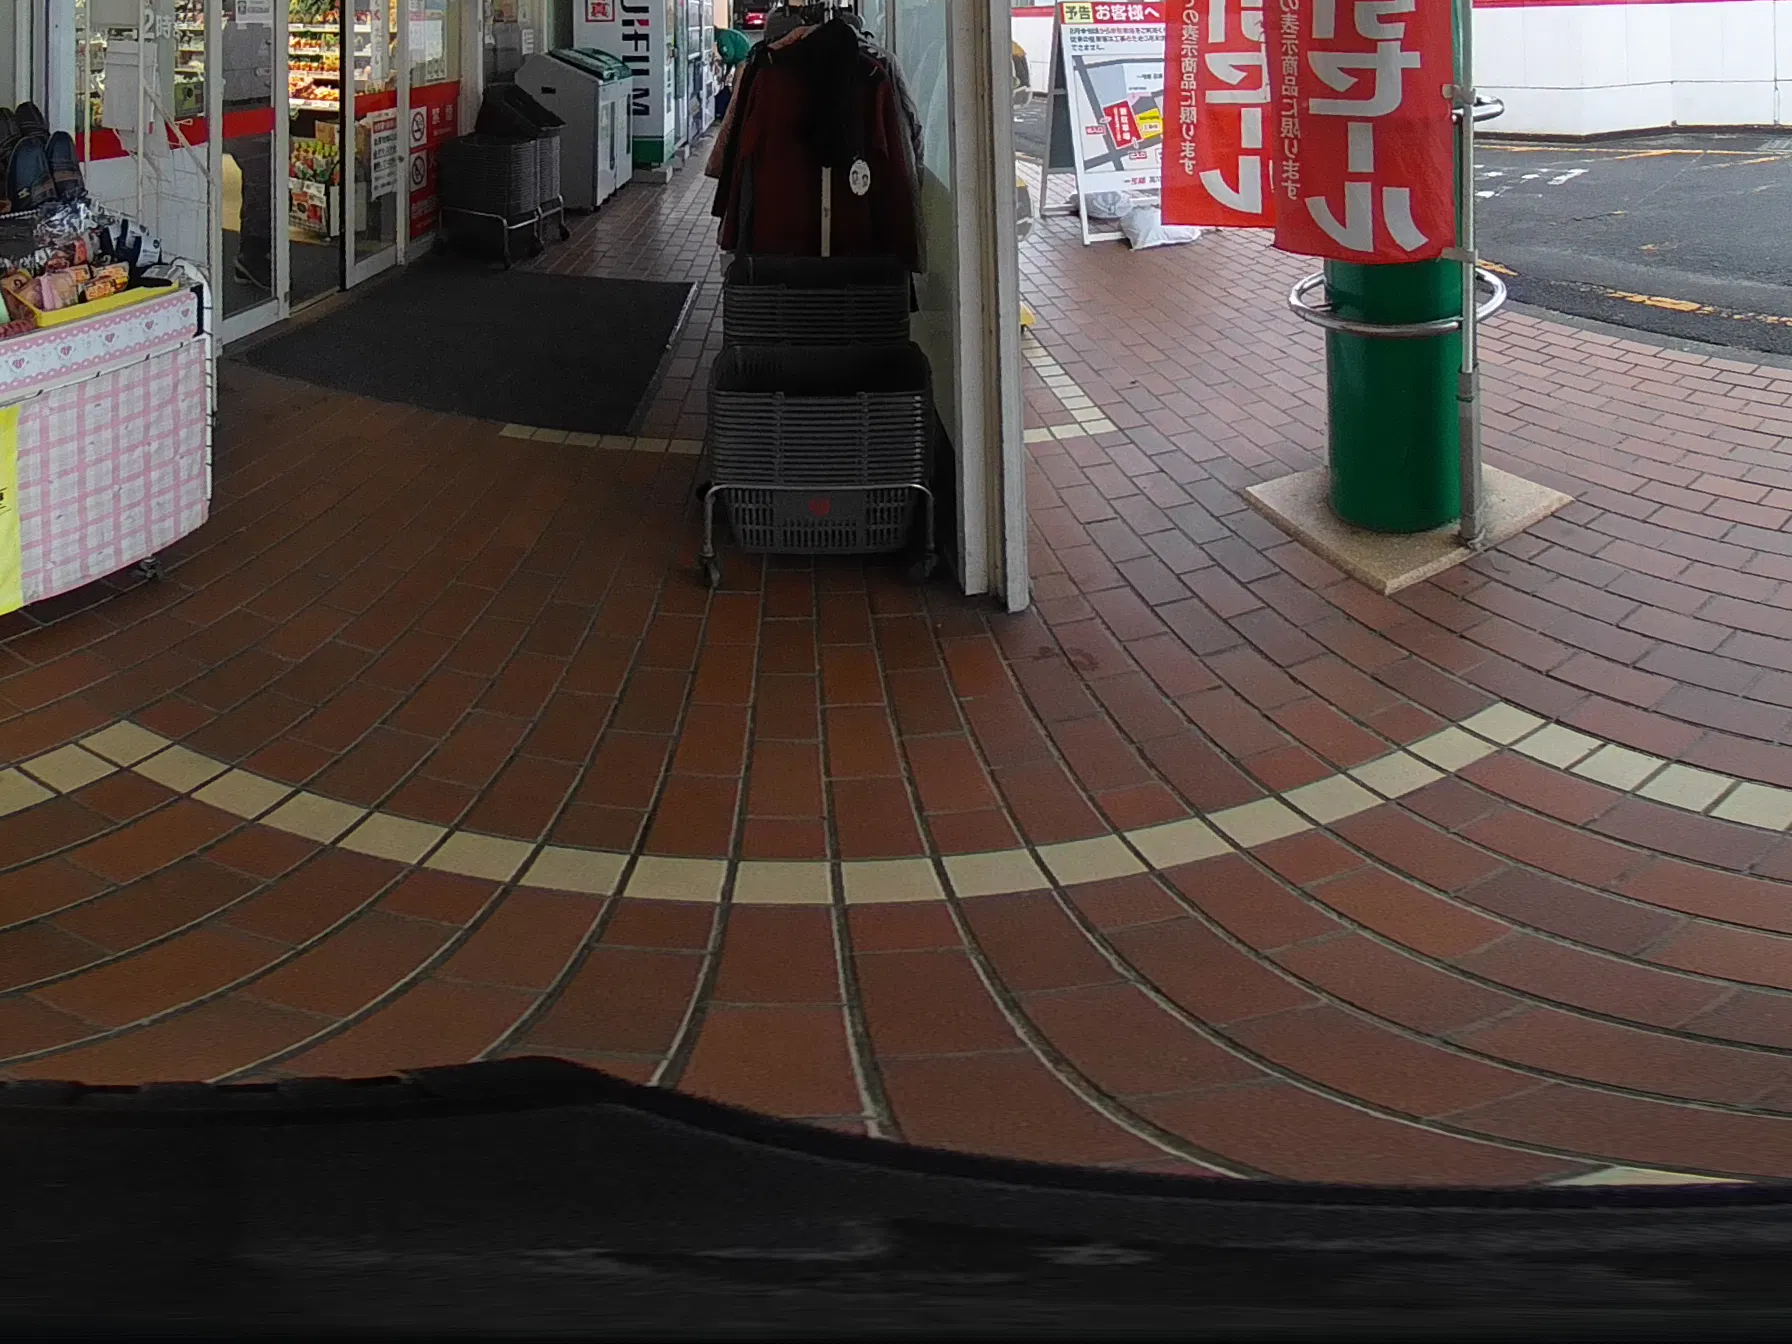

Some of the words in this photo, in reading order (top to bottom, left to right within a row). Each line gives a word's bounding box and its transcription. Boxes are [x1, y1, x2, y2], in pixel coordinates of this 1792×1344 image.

[1065, 5, 1091, 20] 予告
[1094, 3, 1161, 21] お客様へ
